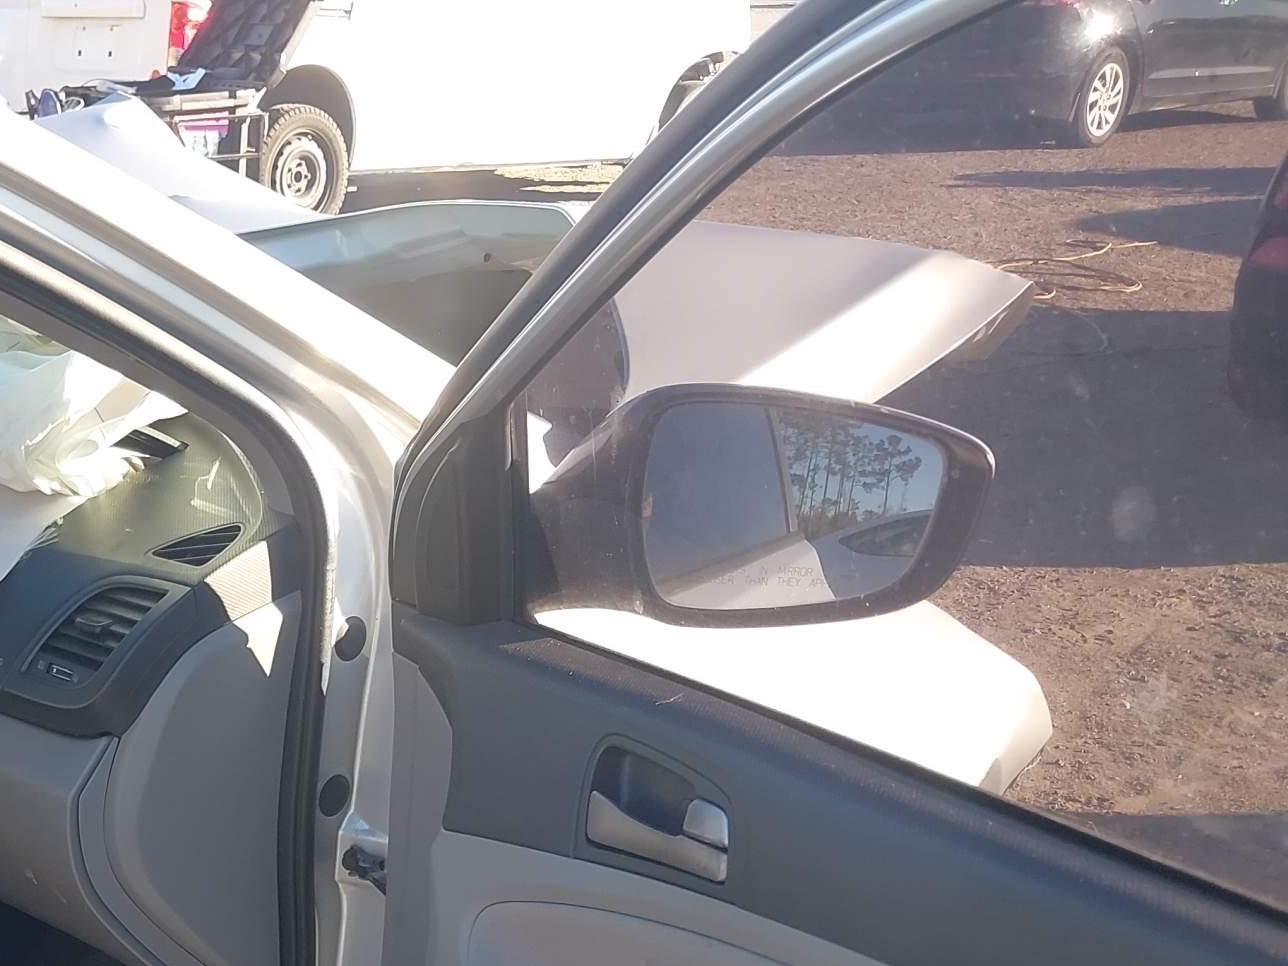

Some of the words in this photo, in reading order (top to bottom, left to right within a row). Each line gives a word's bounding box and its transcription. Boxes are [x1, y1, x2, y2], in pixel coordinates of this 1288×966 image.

[777, 565, 814, 577] MIRROR
[744, 575, 769, 587] THAN
[776, 575, 802, 588] THEY
